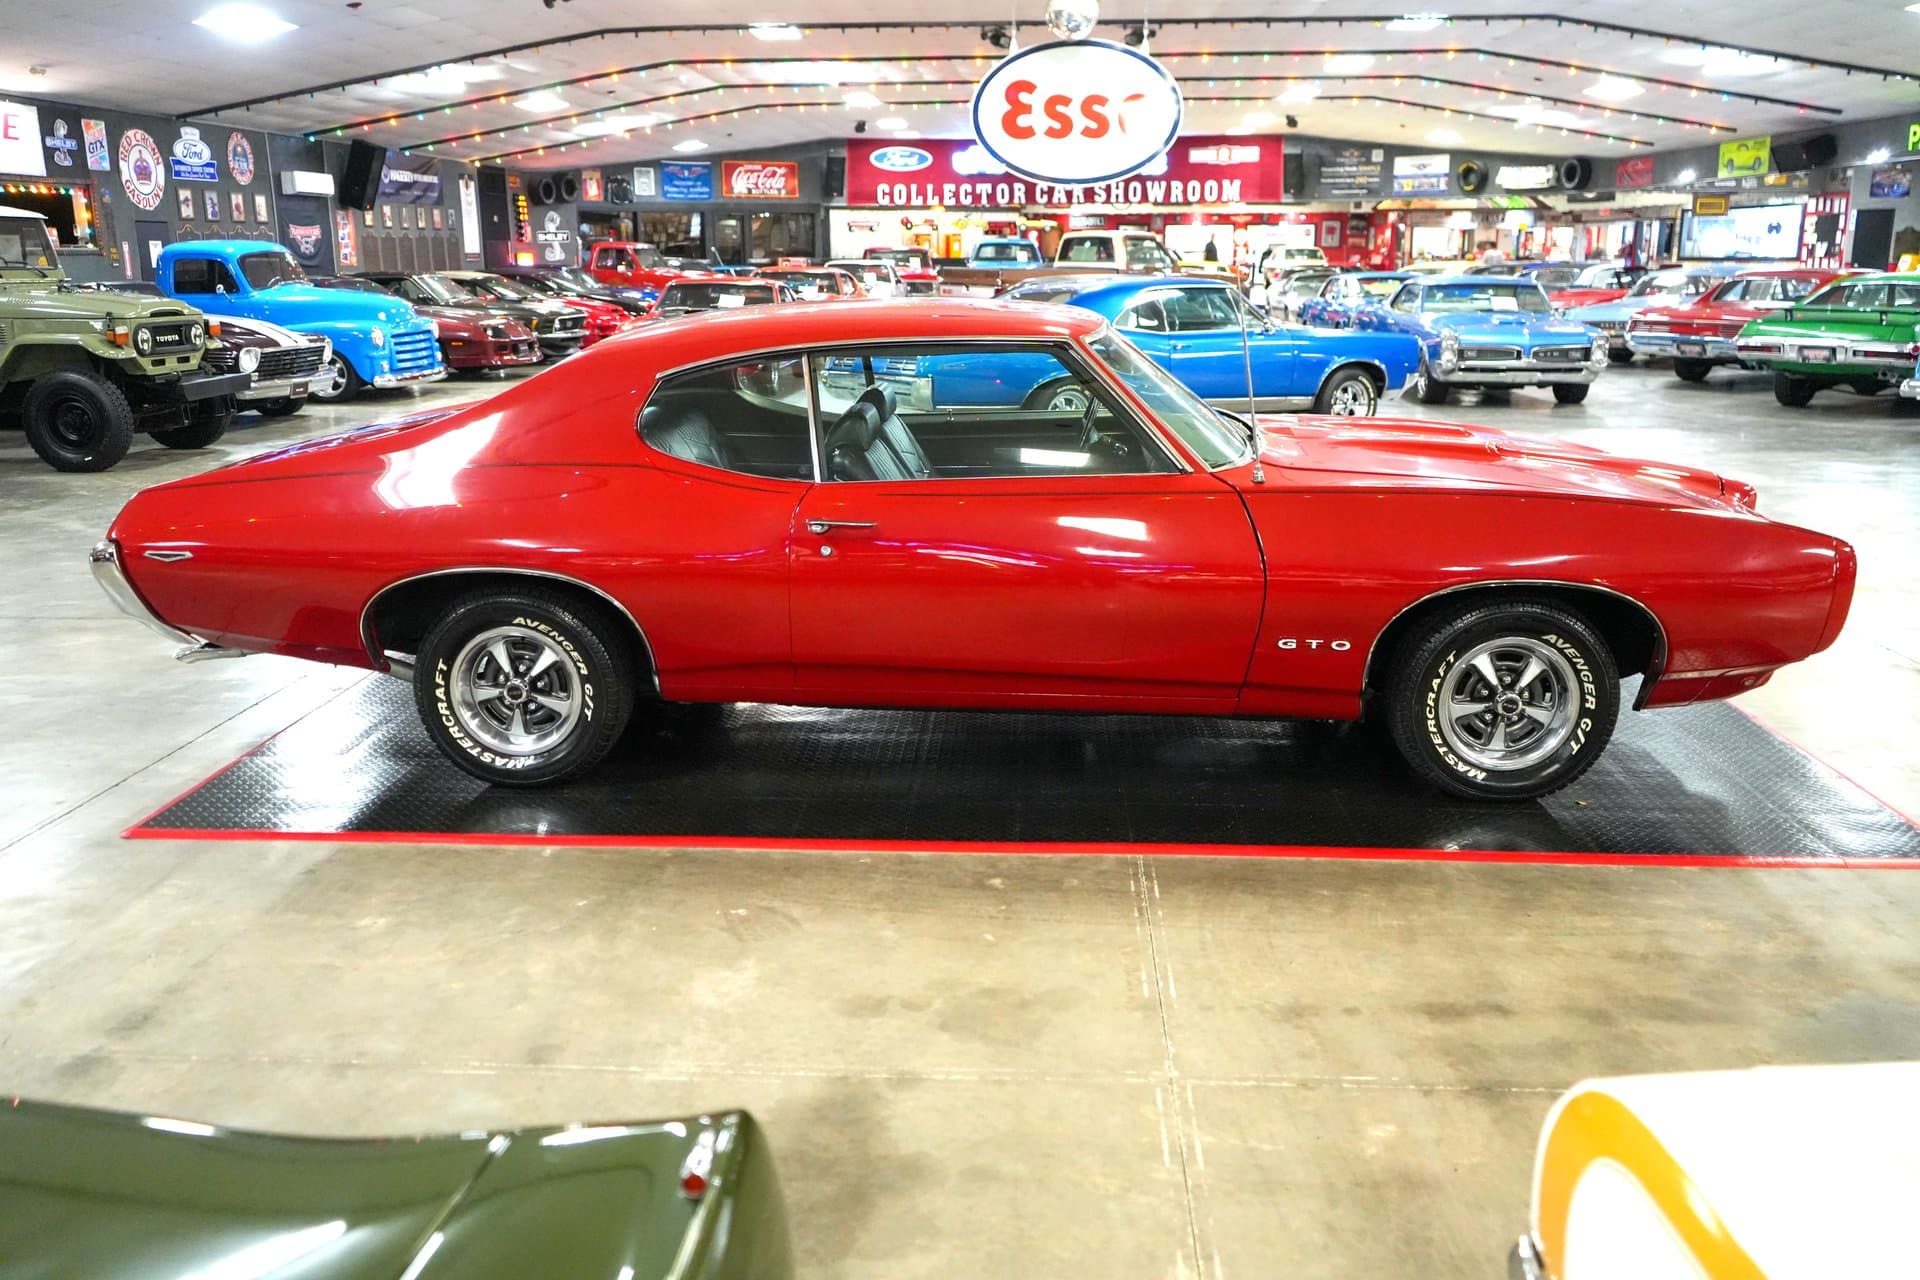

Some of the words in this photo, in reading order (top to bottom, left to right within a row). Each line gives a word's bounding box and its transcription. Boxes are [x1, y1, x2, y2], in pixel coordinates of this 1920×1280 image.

[1001, 79, 1146, 140] Ess
[45, 136, 78, 150] SHELBY
[88, 138, 105, 154] GTX
[120, 135, 133, 162] RED
[133, 130, 162, 166] CROWN
[181, 142, 204, 161] Ford
[731, 166, 787, 190] Coca-Cola
[124, 179, 164, 209] GASOLINE
[876, 183, 1026, 206] COLLECTOR
[1035, 182, 1085, 204] CAR
[1093, 179, 1242, 204] SHOWROOM
[538, 232, 568, 241] SHELBY
[156, 334, 180, 342] TOYOTA
[512, 616, 588, 676] AVENGER
[1278, 639, 1351, 651] GTO
[1541, 633, 1596, 710] AVENGER
[435, 658, 536, 769] MASTERCRAFT
[1425, 650, 1488, 781] MASTERCRAFT
